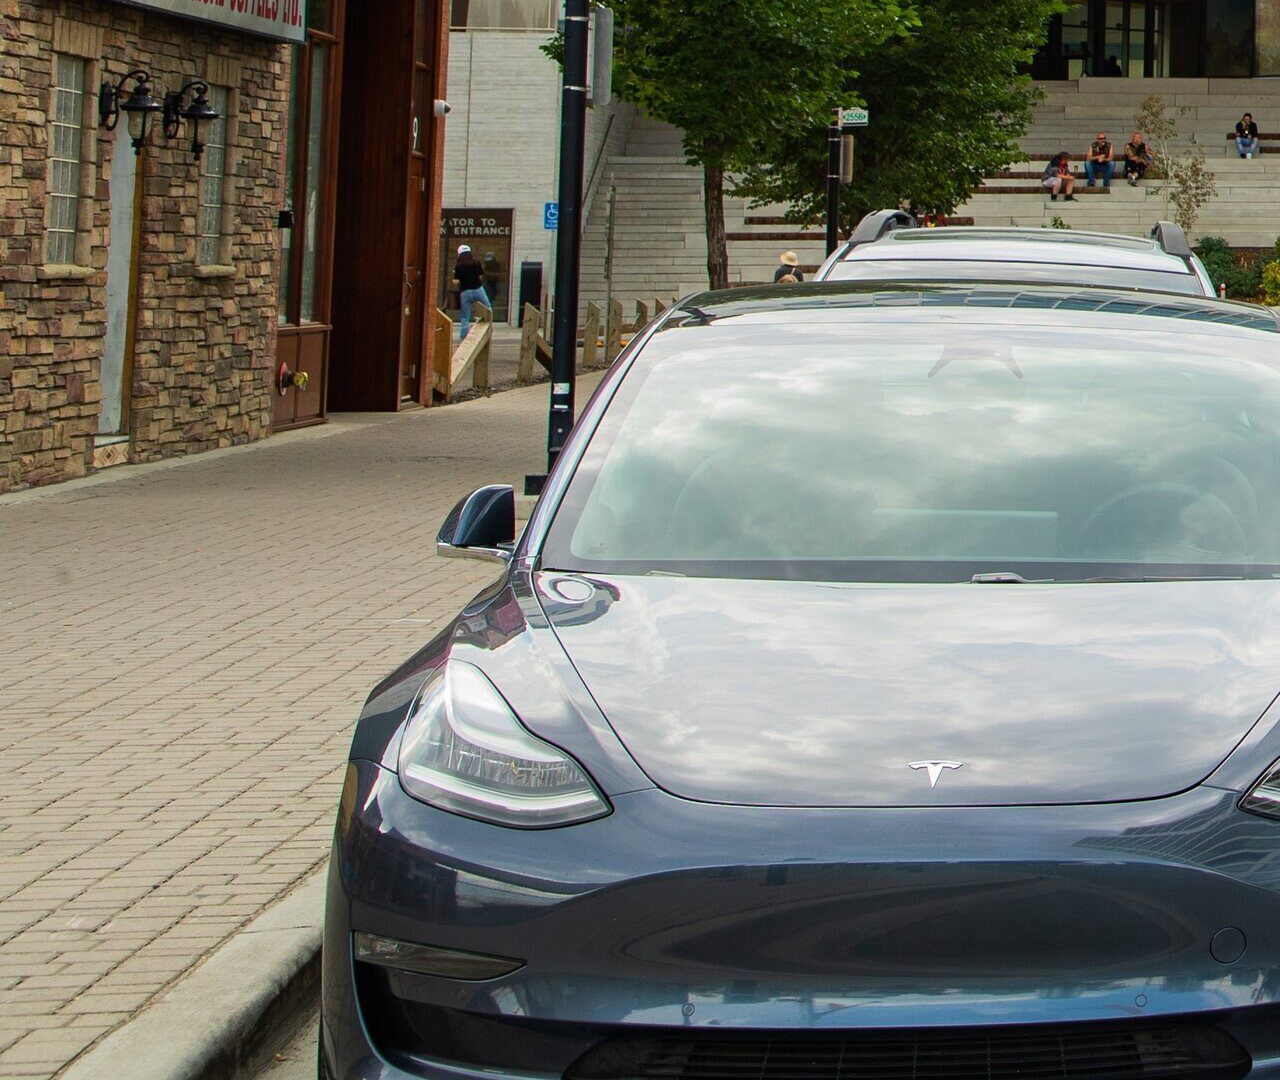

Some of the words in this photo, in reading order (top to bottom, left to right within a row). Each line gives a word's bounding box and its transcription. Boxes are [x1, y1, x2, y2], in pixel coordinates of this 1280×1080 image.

[412, 117, 419, 150] 9
[480, 217, 496, 227] TO
[454, 226, 511, 235] ENTRANCE
